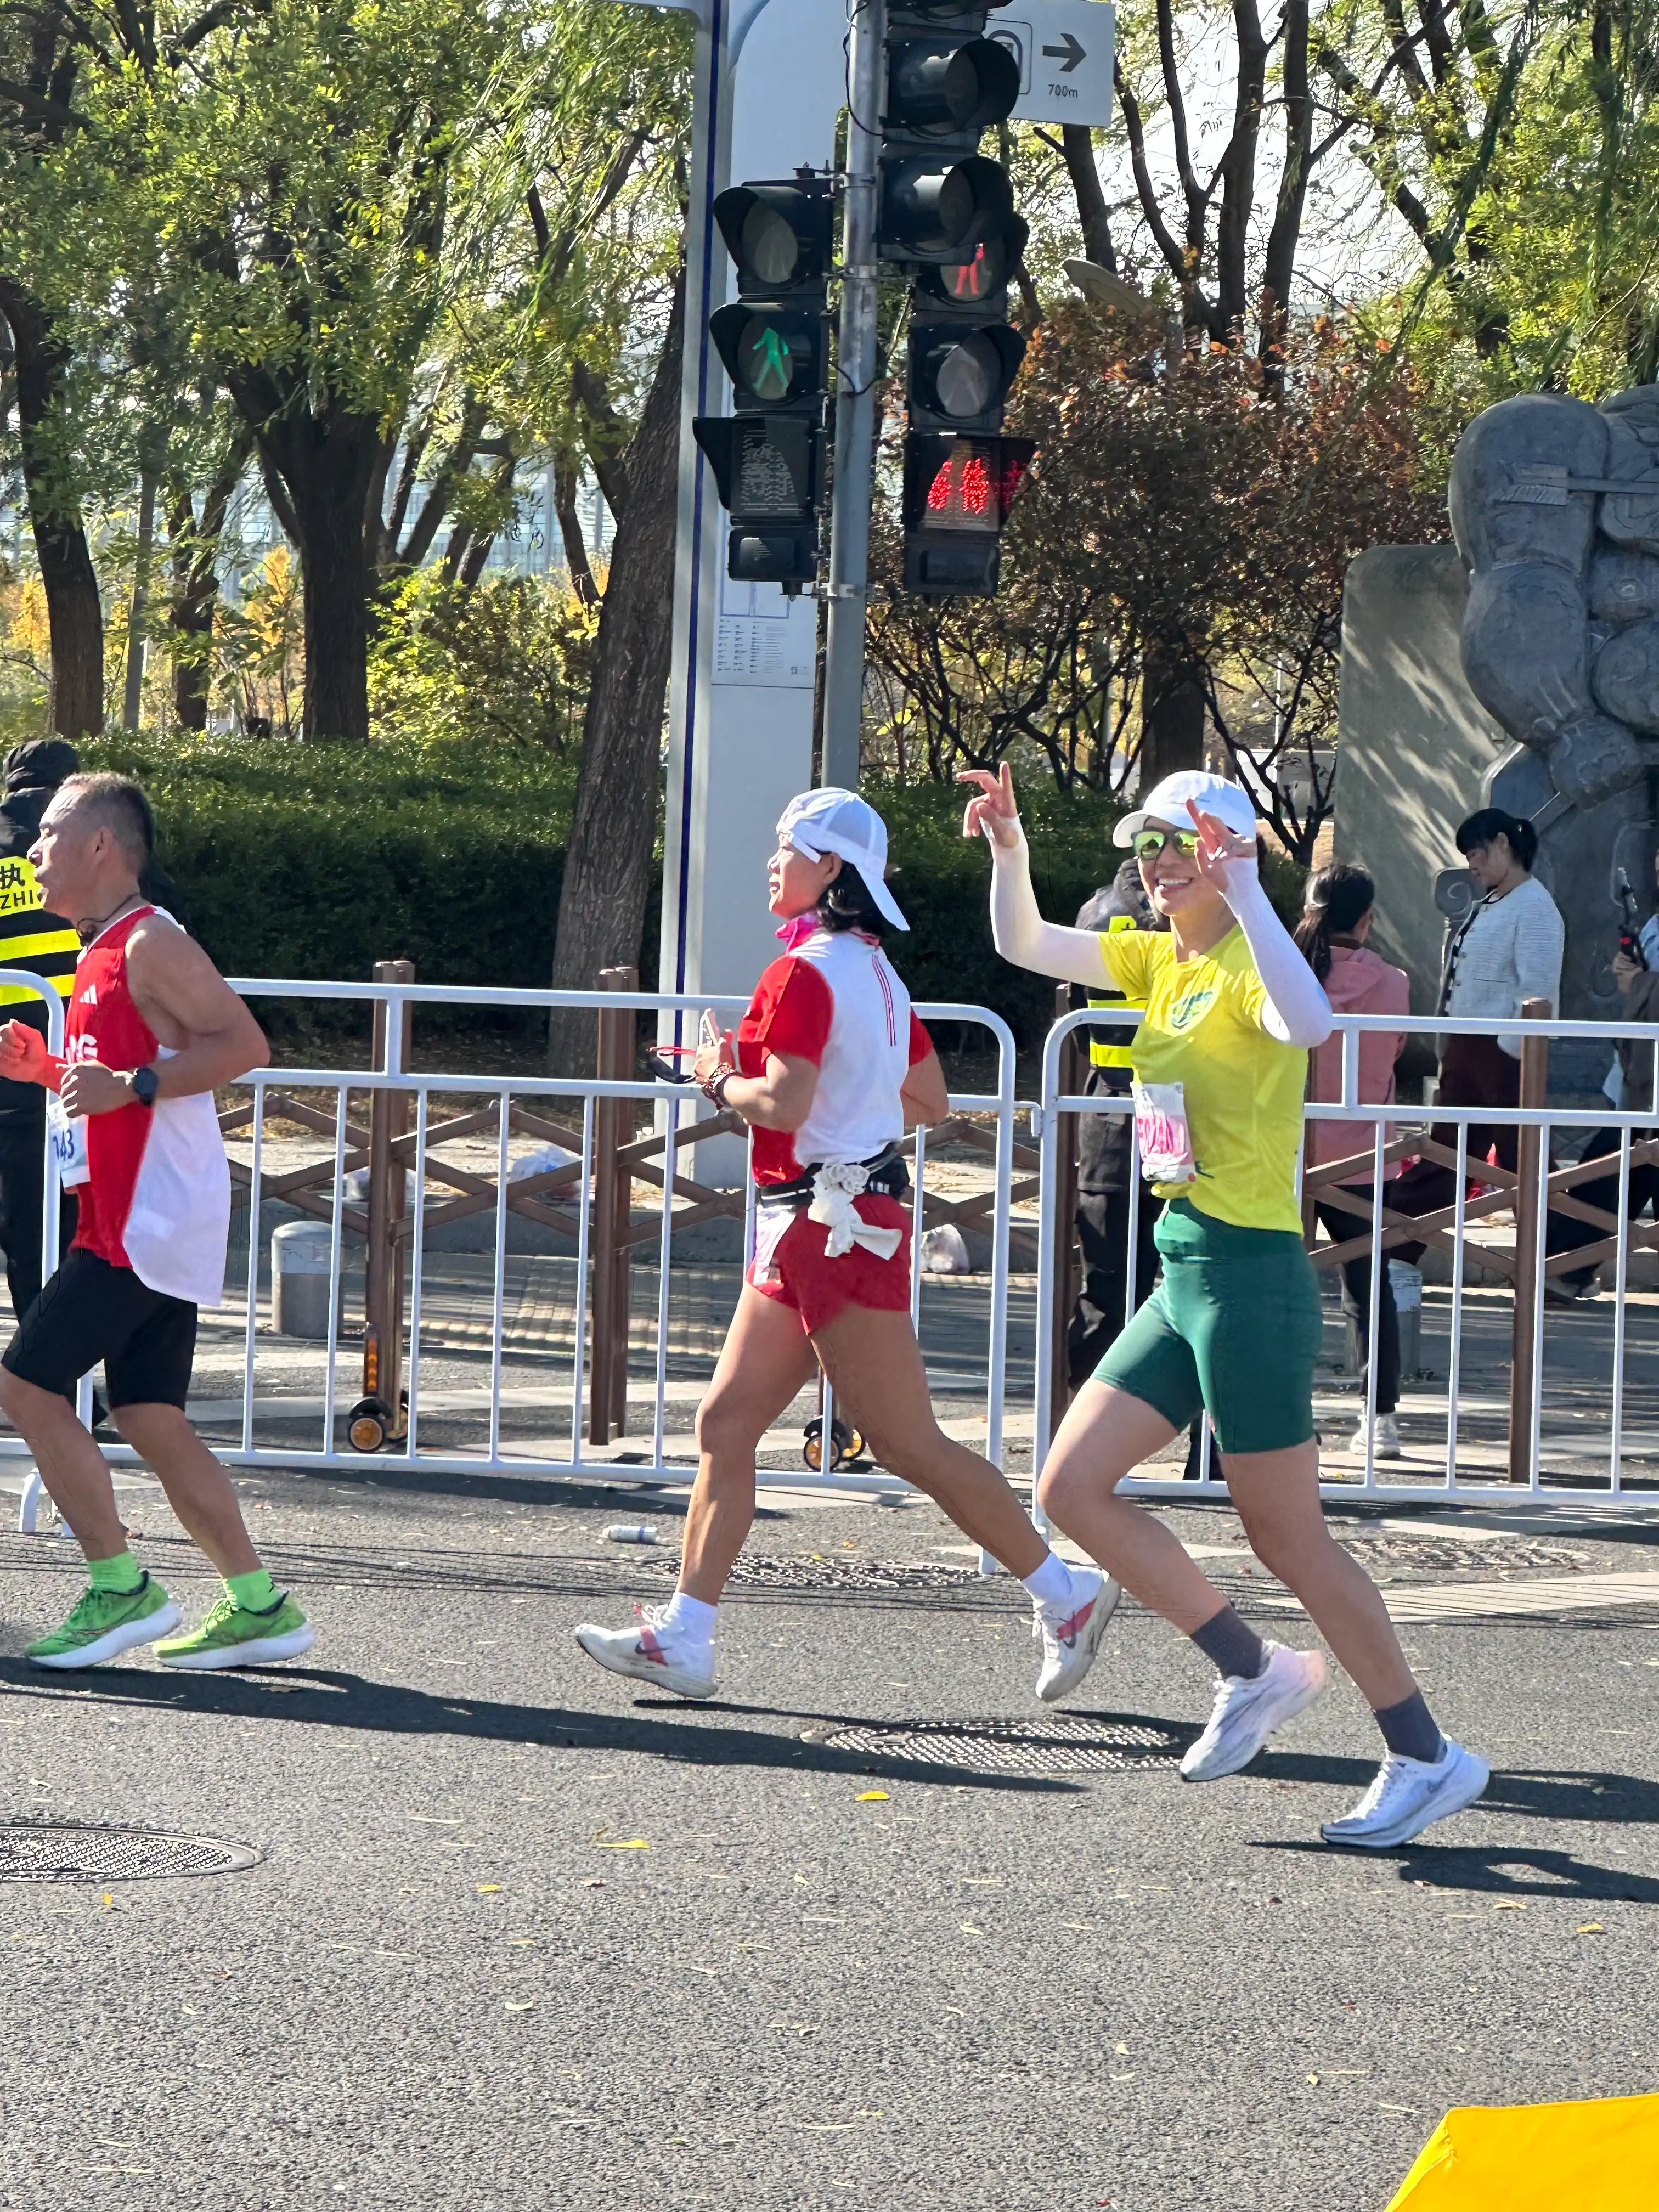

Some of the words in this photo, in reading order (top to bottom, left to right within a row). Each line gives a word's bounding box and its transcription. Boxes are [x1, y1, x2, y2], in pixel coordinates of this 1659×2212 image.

[1048, 83, 1078, 98] 700m
[0, 863, 25, 889] 执
[0, 889, 33, 910] ZHI
